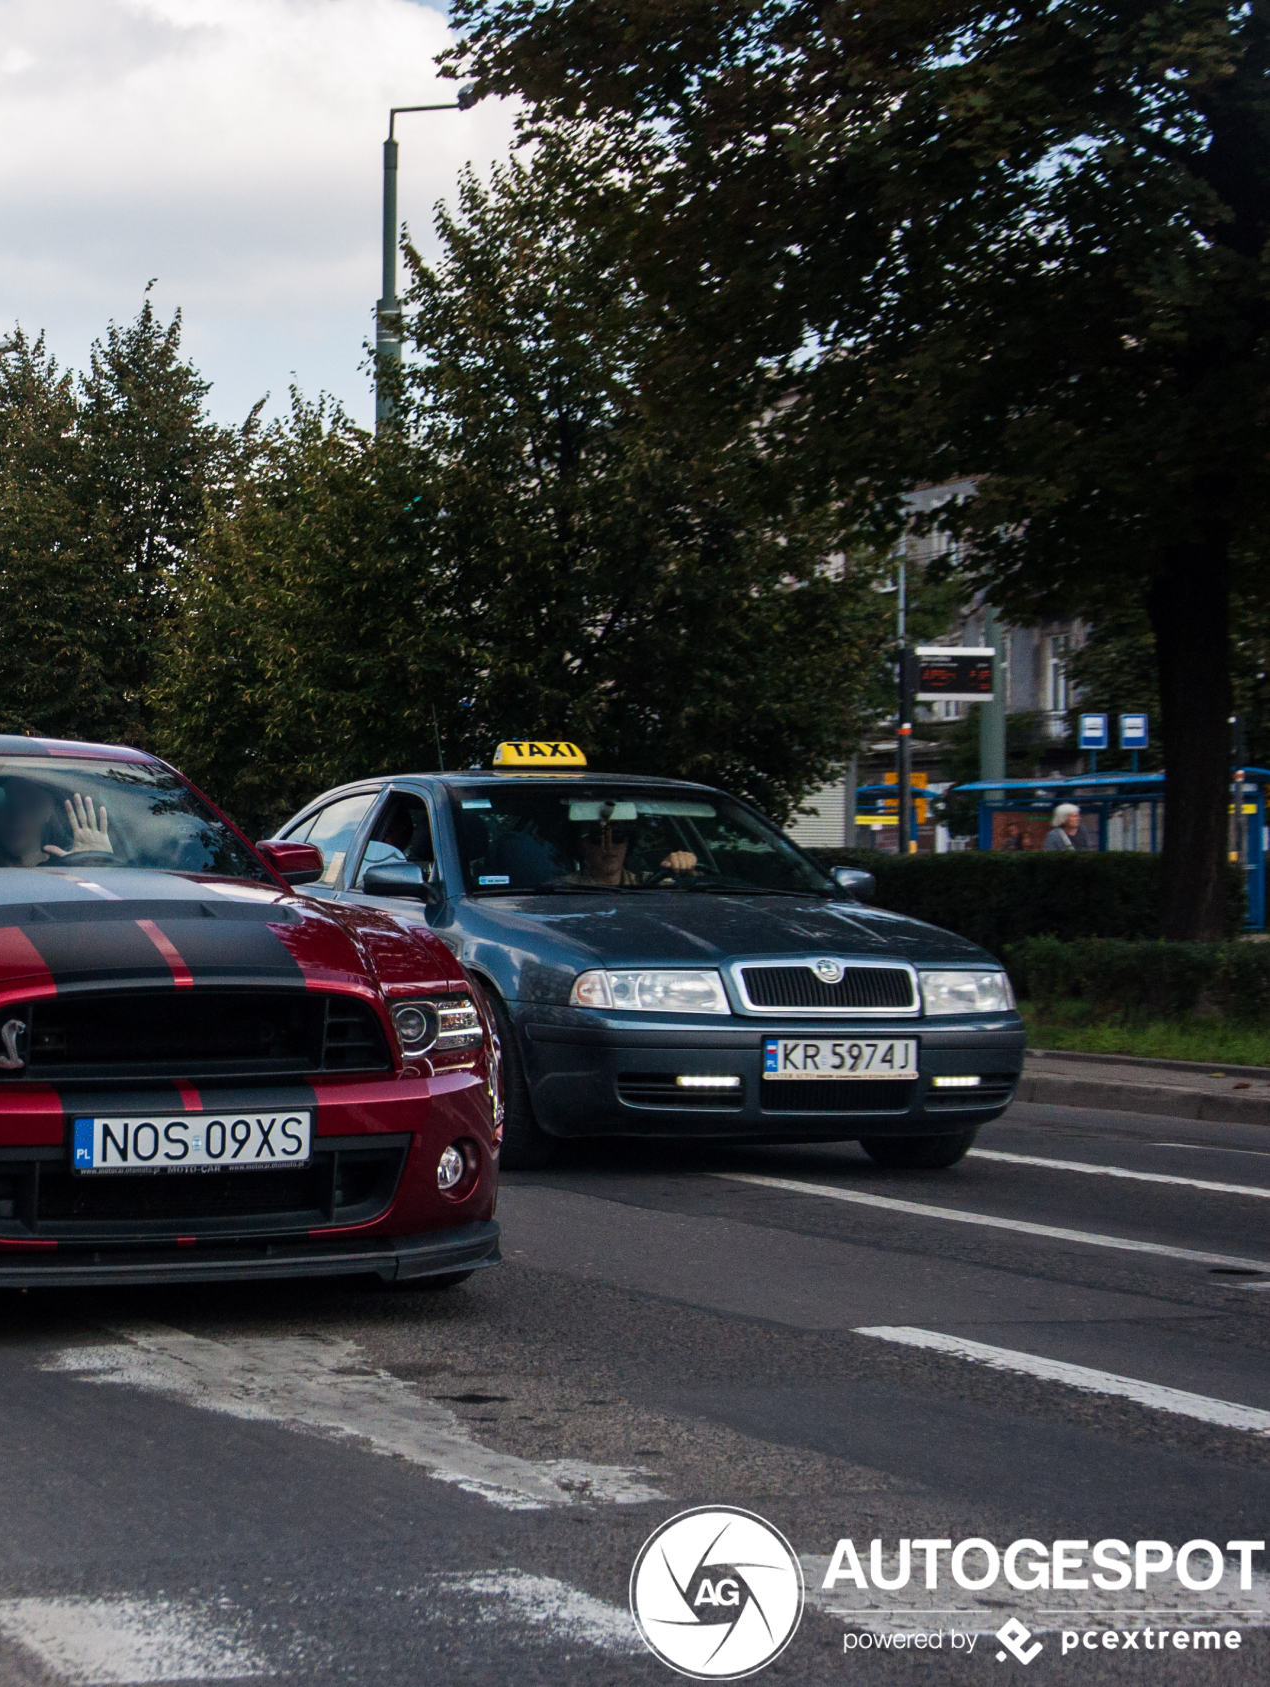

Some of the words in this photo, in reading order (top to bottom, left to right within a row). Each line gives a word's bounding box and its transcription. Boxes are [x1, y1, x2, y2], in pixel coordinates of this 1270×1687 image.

[507, 743, 578, 757] TAXI
[783, 1043, 820, 1070] KR
[830, 1043, 910, 1071] 5974J
[101, 1121, 190, 1163] NOS
[205, 1116, 303, 1159] 09XS
[76, 1149, 90, 1159] PL
[167, 1165, 222, 1173] MOTO-CAR
